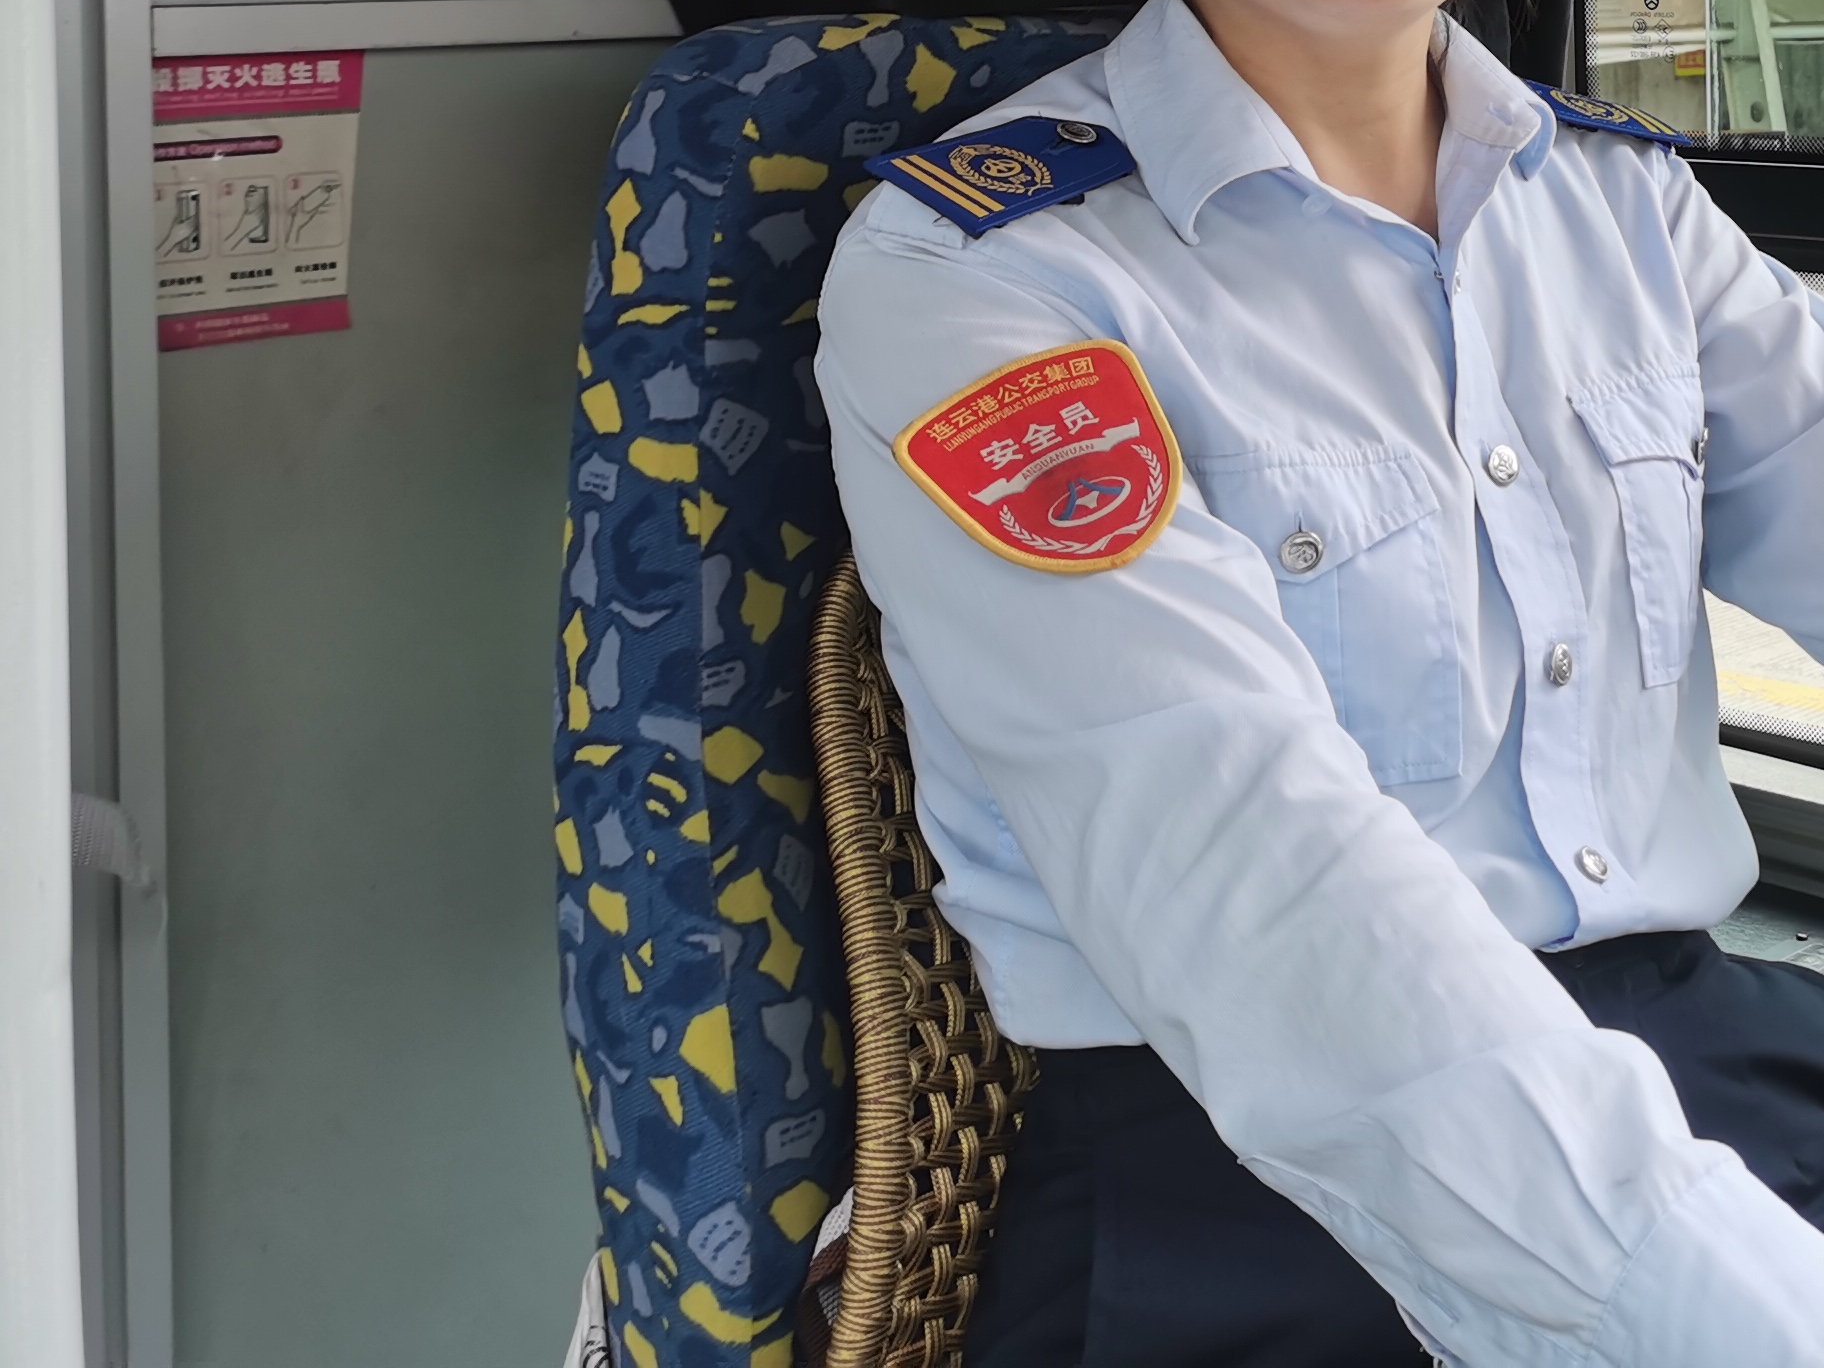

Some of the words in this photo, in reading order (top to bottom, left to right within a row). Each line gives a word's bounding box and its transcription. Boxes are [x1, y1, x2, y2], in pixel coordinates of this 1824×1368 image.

[926, 356, 1095, 443] 连云港公交集团
[1023, 381, 1071, 408] TRANSPORT
[1069, 375, 1100, 391] GROUP
[980, 401, 1100, 470] 安全员
